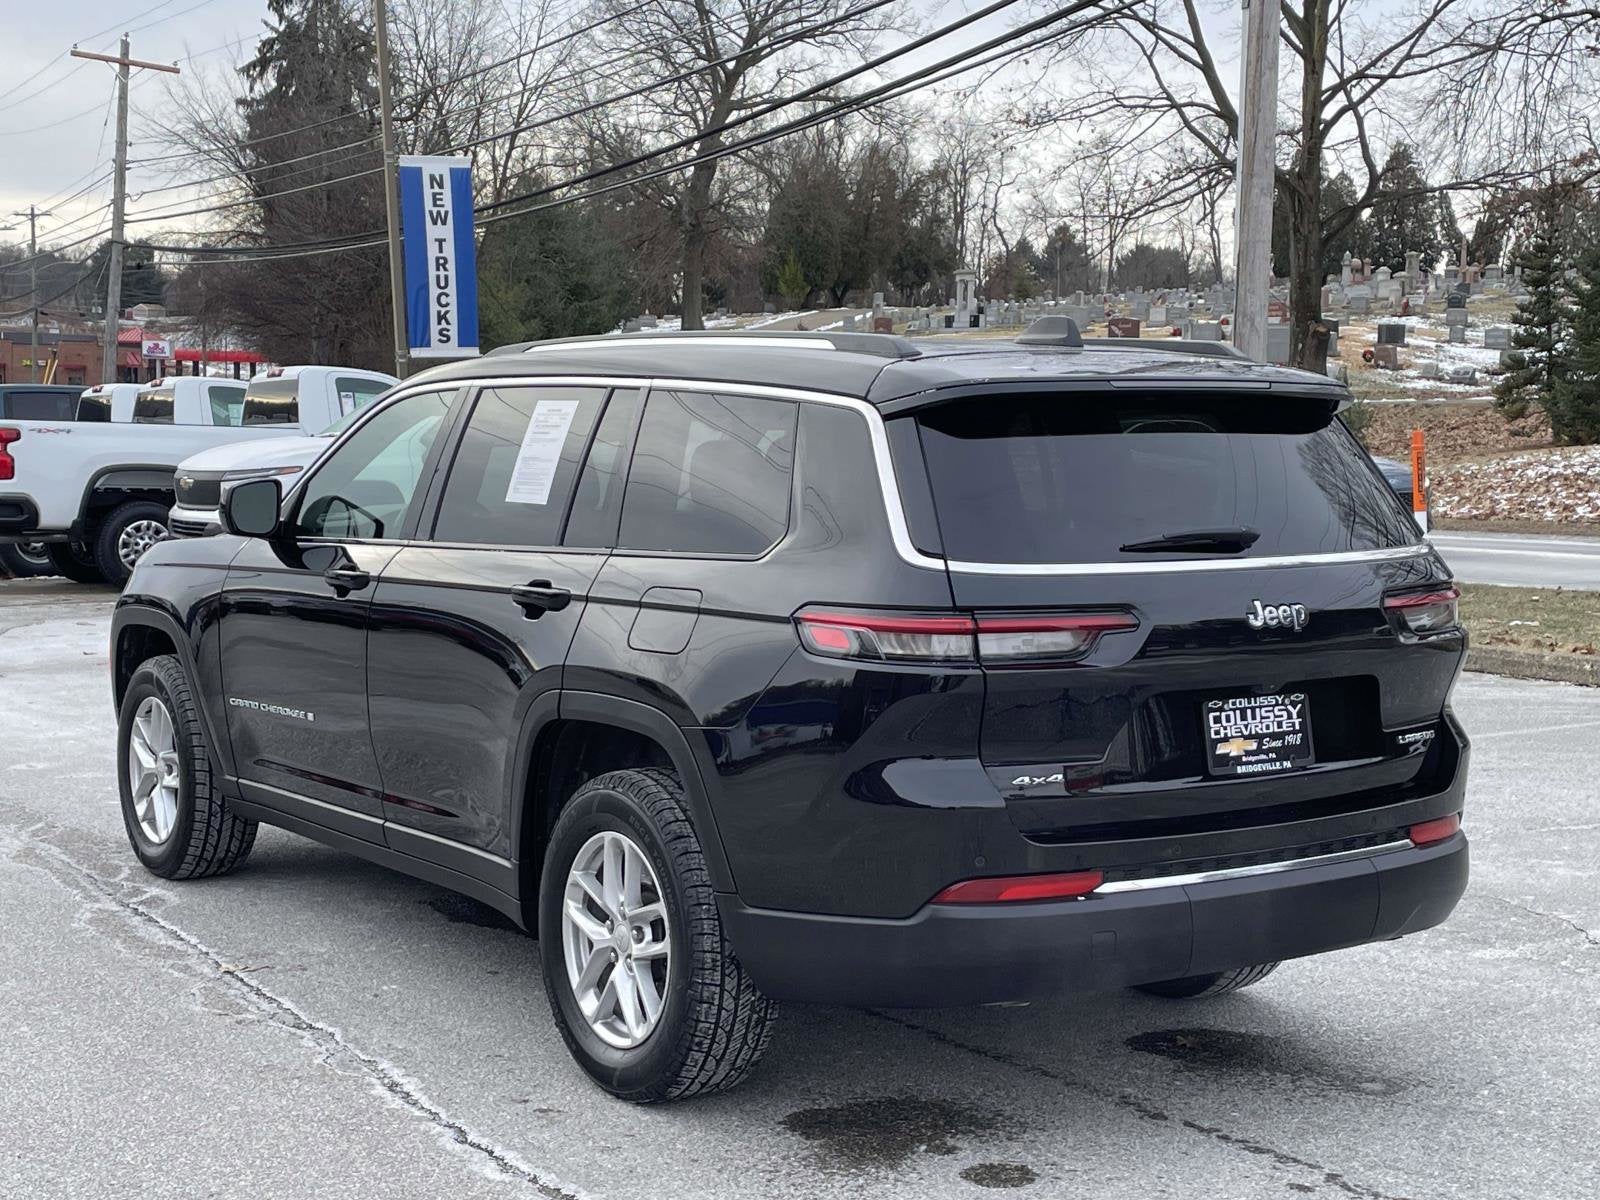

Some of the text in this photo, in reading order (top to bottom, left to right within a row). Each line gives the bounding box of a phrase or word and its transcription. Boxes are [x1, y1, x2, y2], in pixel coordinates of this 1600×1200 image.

[428, 173, 452, 344] NEW TRUCKS
[1246, 599, 1309, 632] Jeep
[229, 697, 259, 710] GRAND
[260, 703, 306, 719] CHEROKEE
[1228, 694, 1285, 709] COLUSSY
[1208, 703, 1302, 728] COLUSSY
[1210, 718, 1303, 739] CHEVROLET
[1261, 733, 1302, 750] Since 1918
[1283, 760, 1292, 769] PA
[1011, 773, 1065, 785] 4x4
